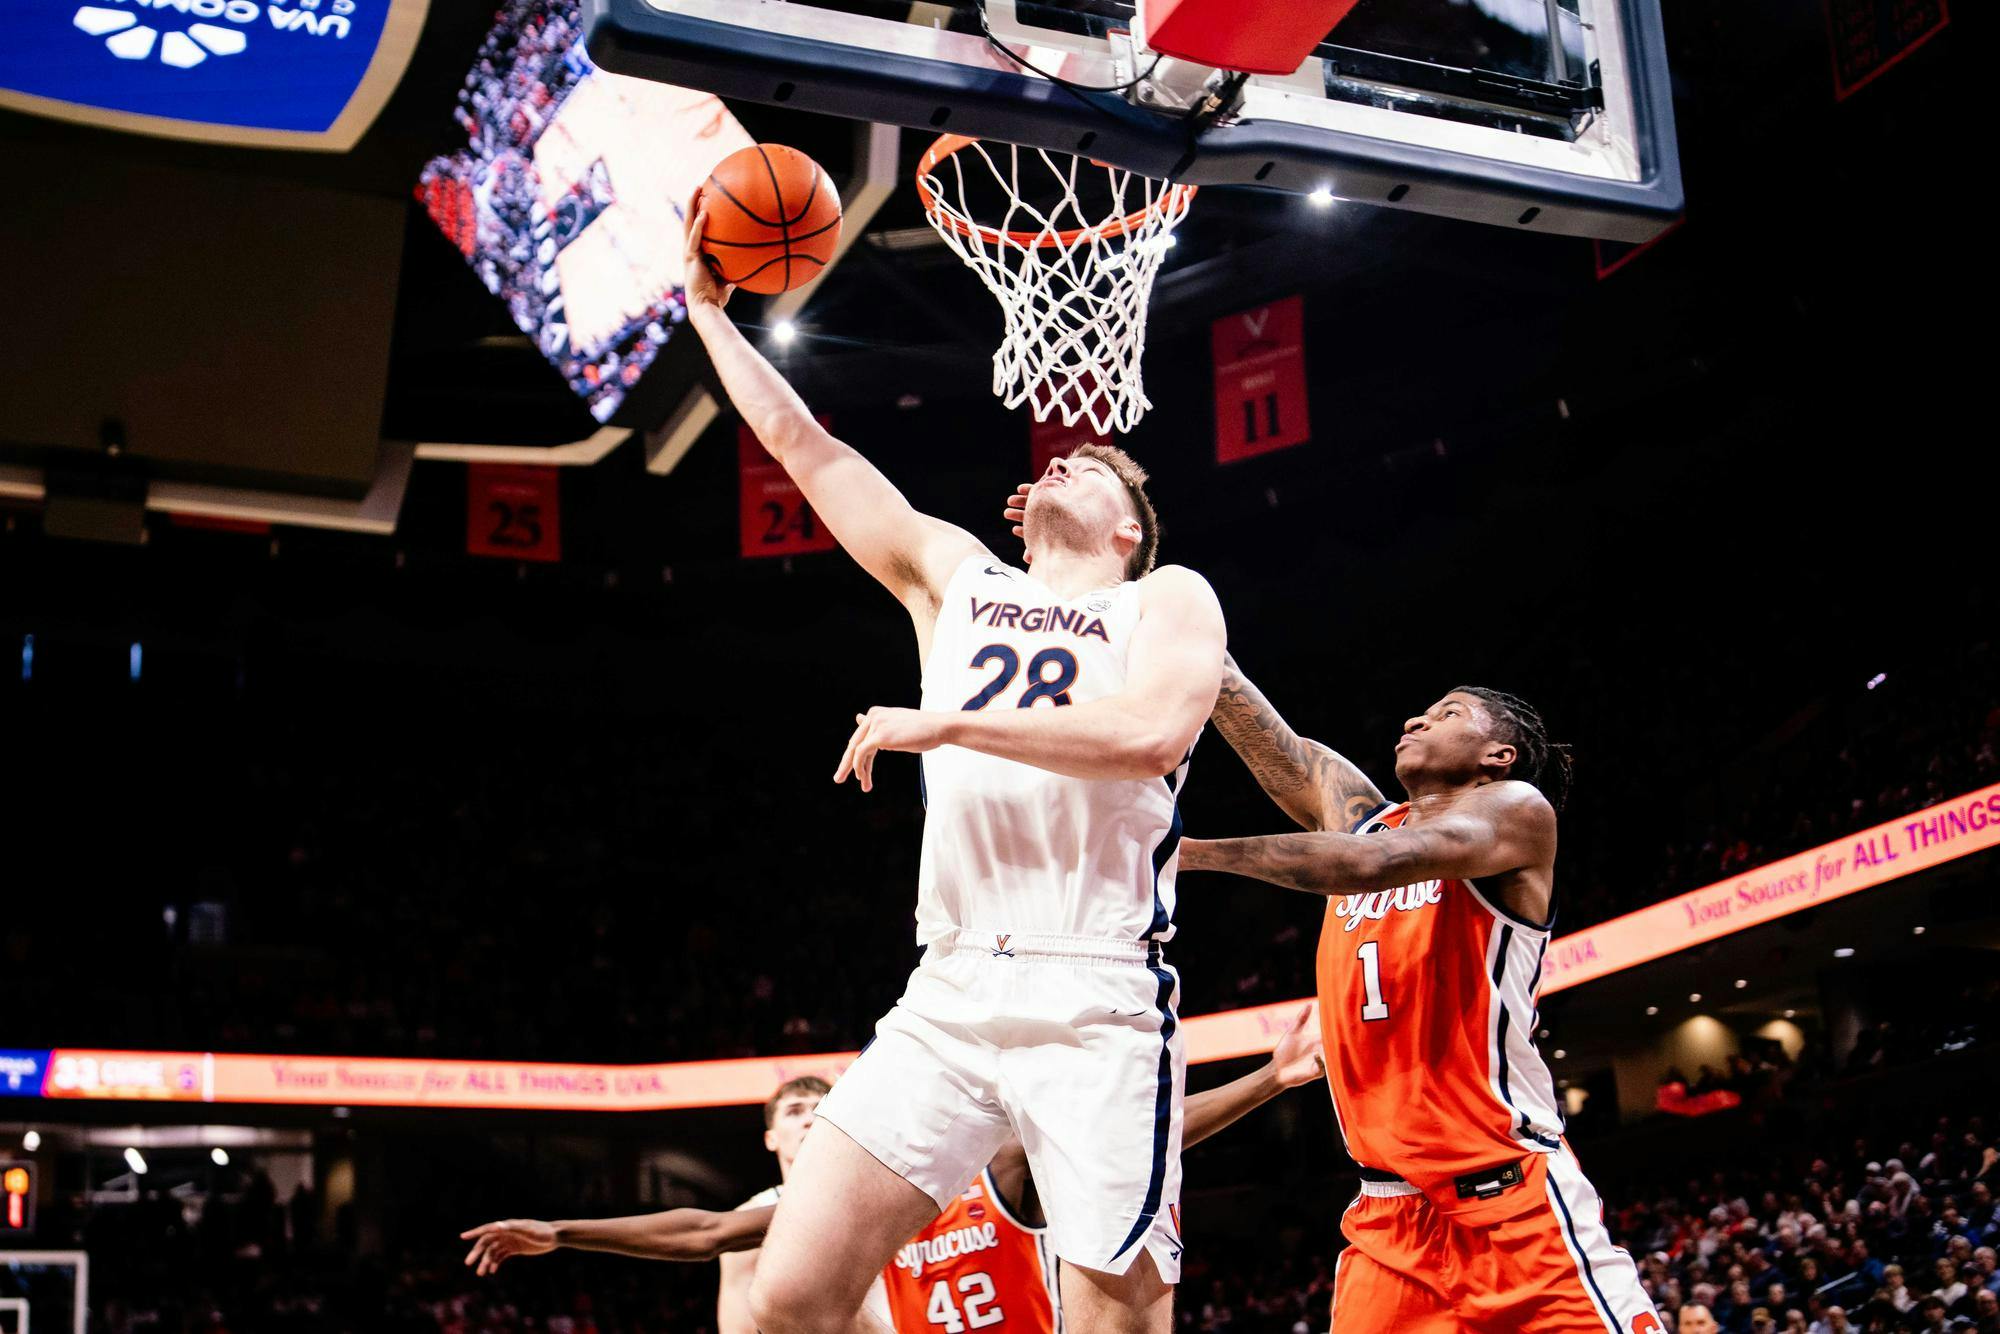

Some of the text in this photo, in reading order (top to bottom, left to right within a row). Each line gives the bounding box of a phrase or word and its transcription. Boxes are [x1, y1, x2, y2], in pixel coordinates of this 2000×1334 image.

[268, 5, 350, 39] UVA
[1244, 393, 1279, 443] 11
[487, 500, 543, 547] 25
[760, 499, 816, 545] 24
[970, 597, 1111, 644] VIRGINIA
[960, 642, 1080, 711] 28
[1683, 793, 2000, 929] Your Source for ALL THINGS
[1356, 940, 1390, 1022] 1
[926, 1271, 1005, 1334] 42
